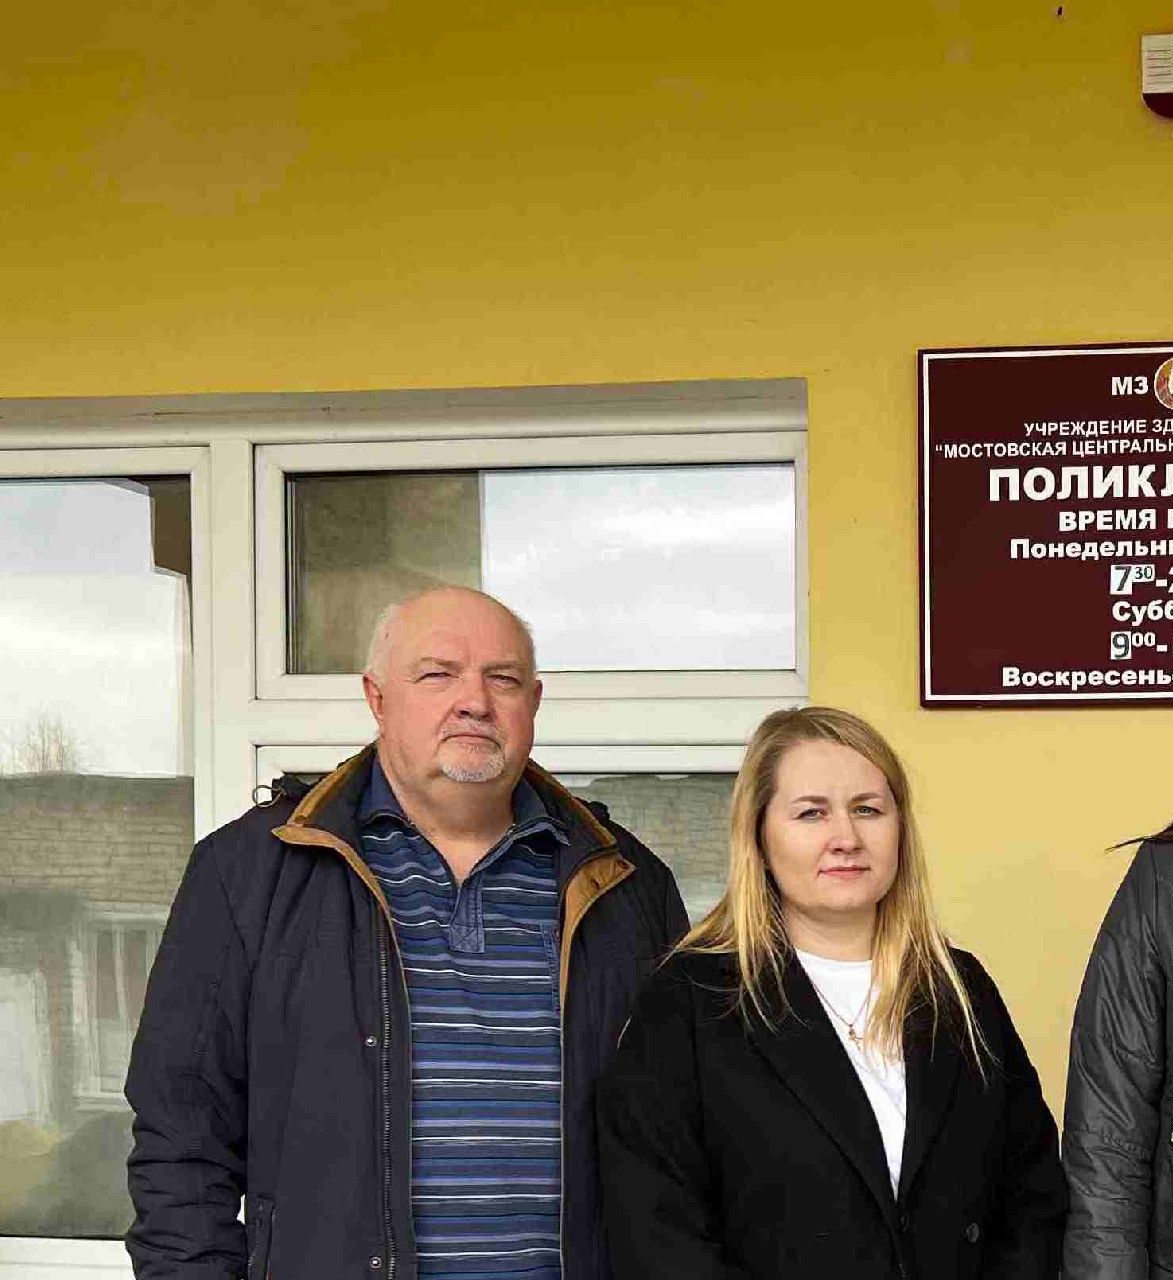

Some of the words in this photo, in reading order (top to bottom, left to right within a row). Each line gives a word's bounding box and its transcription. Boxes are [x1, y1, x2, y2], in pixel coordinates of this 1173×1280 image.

[1111, 376, 1148, 395] МЗ
[1024, 420, 1147, 438] УЧРЕЖДЕНИЕ
[1058, 509, 1157, 532] ВРЕМЯ
